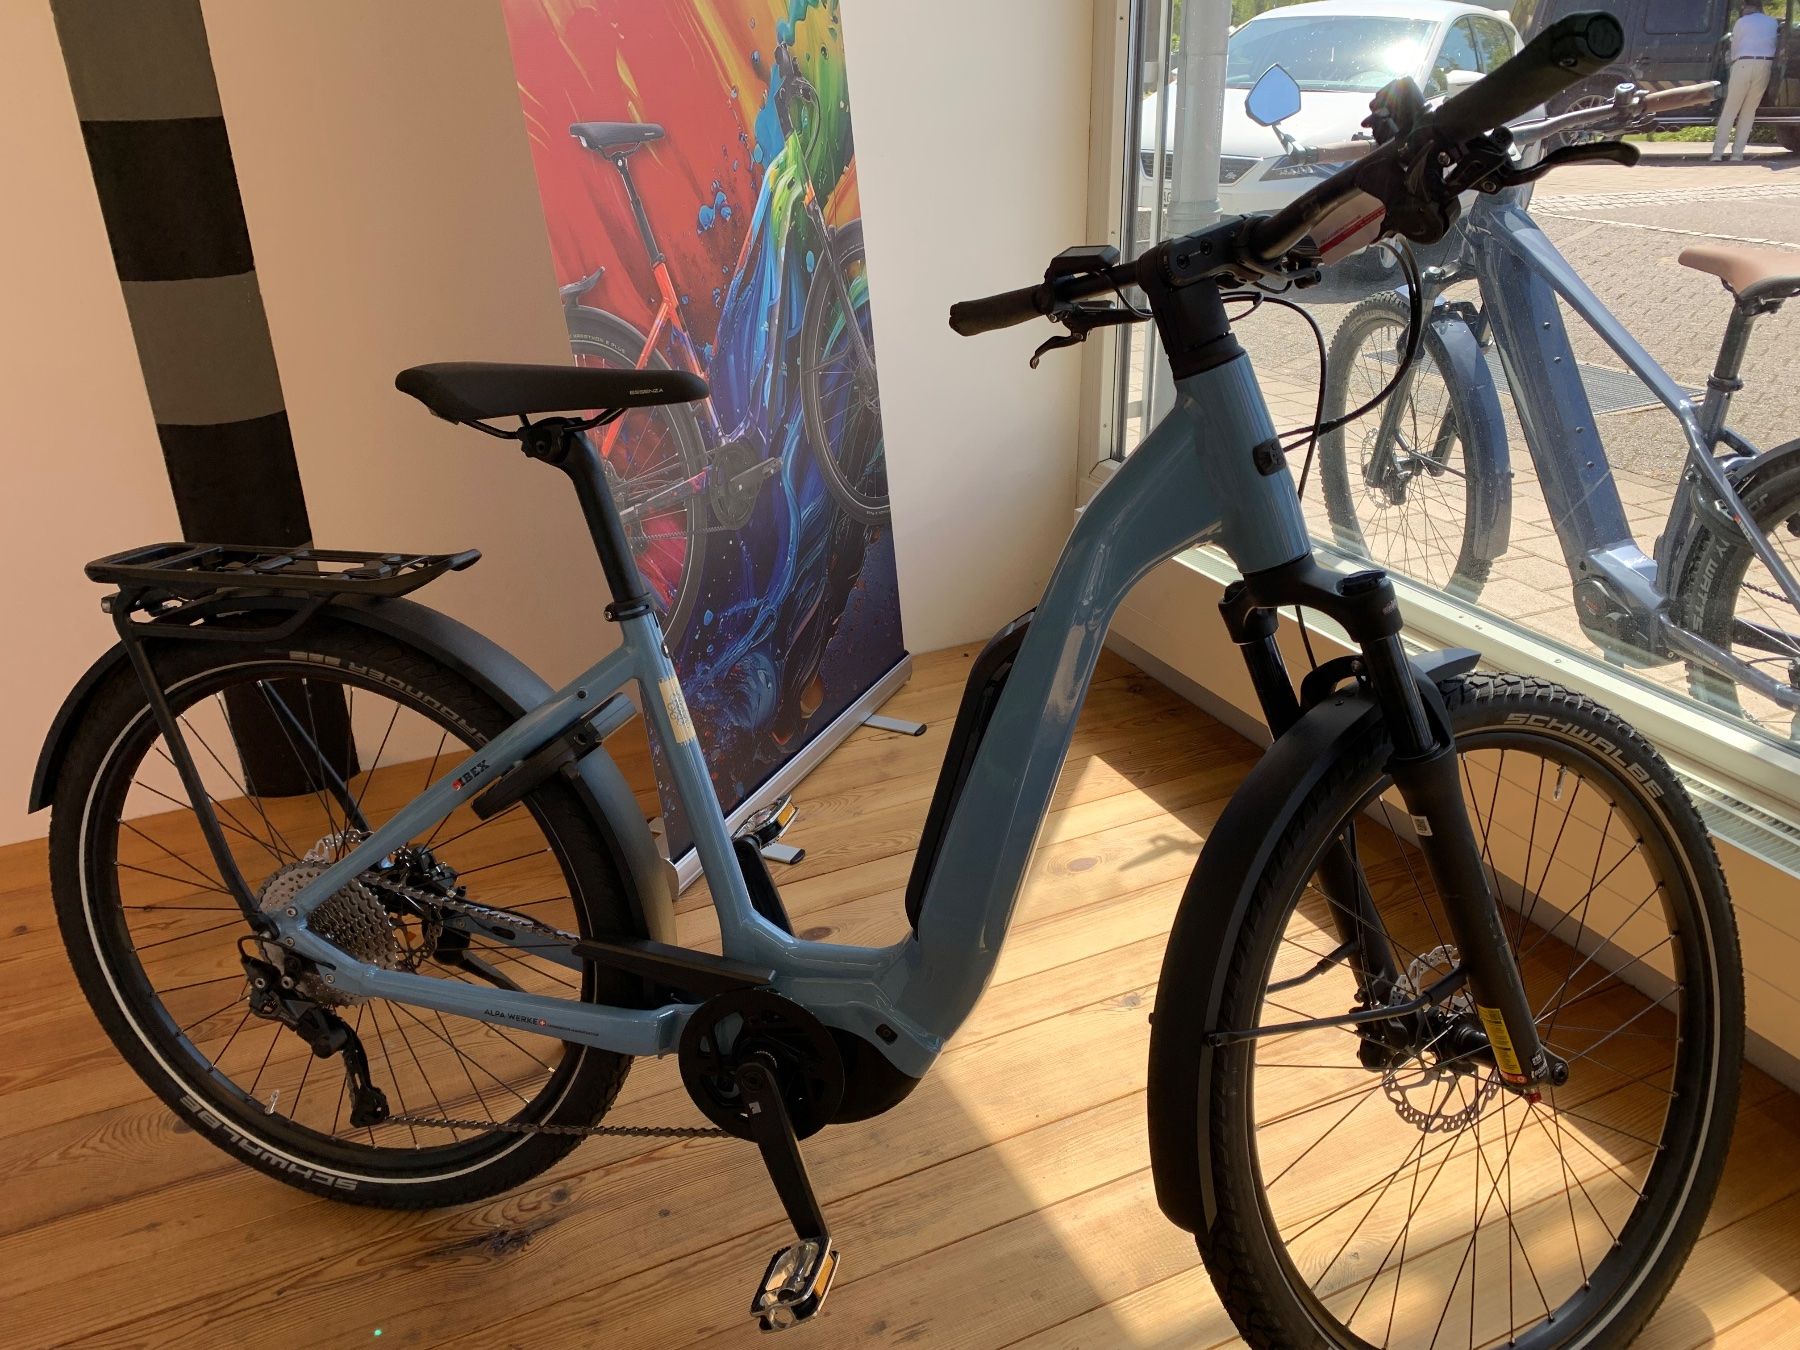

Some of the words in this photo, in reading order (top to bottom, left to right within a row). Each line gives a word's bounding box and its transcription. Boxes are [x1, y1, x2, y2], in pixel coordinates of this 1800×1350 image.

[459, 759, 490, 787] IBEX
[1503, 712, 1665, 799] SCHWALBE
[484, 1008, 506, 1018] ALPA
[507, 1012, 539, 1025] WERKE
[179, 1094, 358, 1191] SCHWALBE
